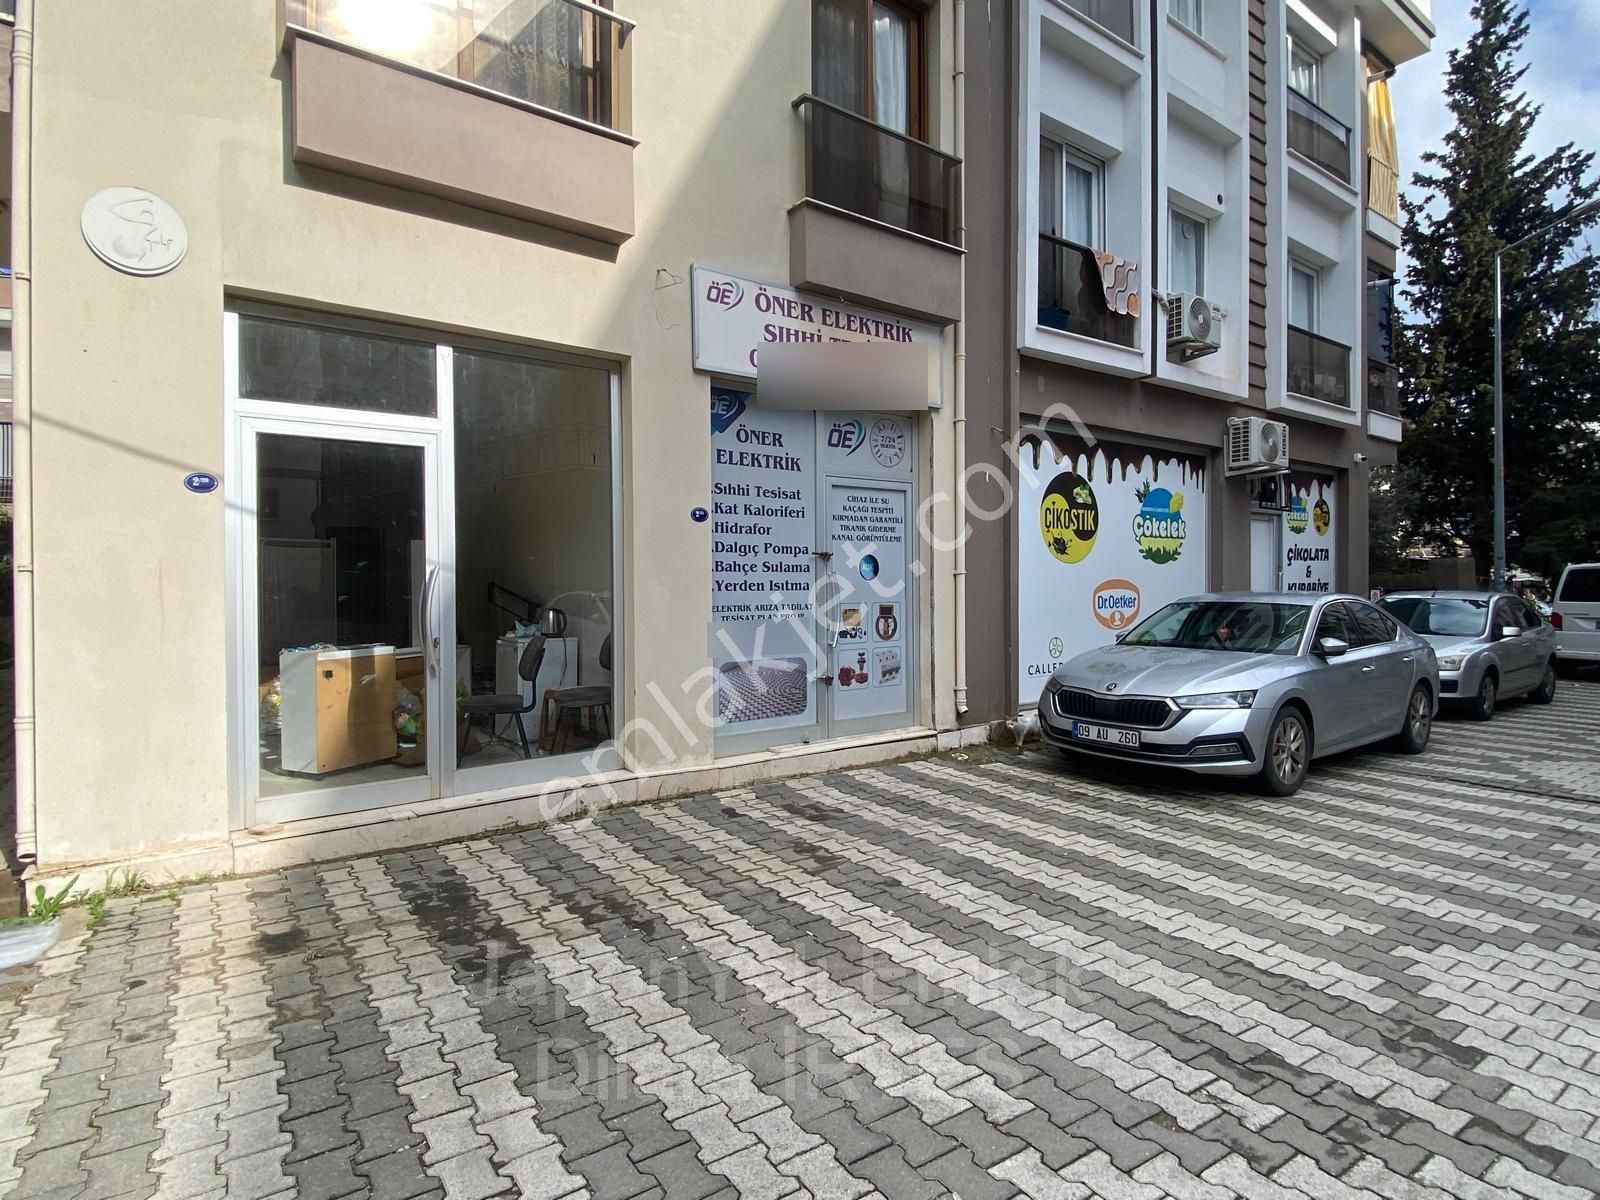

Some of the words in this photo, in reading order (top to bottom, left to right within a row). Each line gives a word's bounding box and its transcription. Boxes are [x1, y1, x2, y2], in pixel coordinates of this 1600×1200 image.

[755, 287, 814, 323] ÖNER
[821, 308, 913, 342] ELEKTRİK
[736, 424, 784, 447] ÖNER
[716, 449, 802, 472] ELEKTRİK
[754, 486, 802, 500] Tesisat
[847, 494, 868, 503] CİHAZ
[869, 496, 880, 504] İLE
[743, 504, 805, 518] Kaloriferi
[842, 504, 869, 513] KAÇAĞI
[870, 506, 894, 514] TESPİTİ
[832, 514, 868, 522] KIRMADAN
[869, 516, 903, 524] GARANTİLİ
[1044, 501, 1096, 532] ÇİKOSTIK
[840, 524, 866, 532] TIKANIK
[867, 524, 897, 533] GİDERME
[1133, 513, 1187, 543] Çökelek
[855, 533, 903, 543] GÖRÜNTÜLEME
[764, 543, 809, 557] Pompa
[1287, 544, 1329, 566] ÇİKOLATA
[762, 561, 810, 573] Sulama
[1306, 565, 1312, 578] &
[769, 580, 810, 591] Isıtma
[712, 602, 752, 613] ELEKTRİK
[754, 603, 779, 611] ARIZA
[720, 613, 755, 622] TESİSAT
[1078, 724, 1090, 738] 09
[1096, 726, 1109, 740] AU
[1118, 732, 1138, 745] 260
